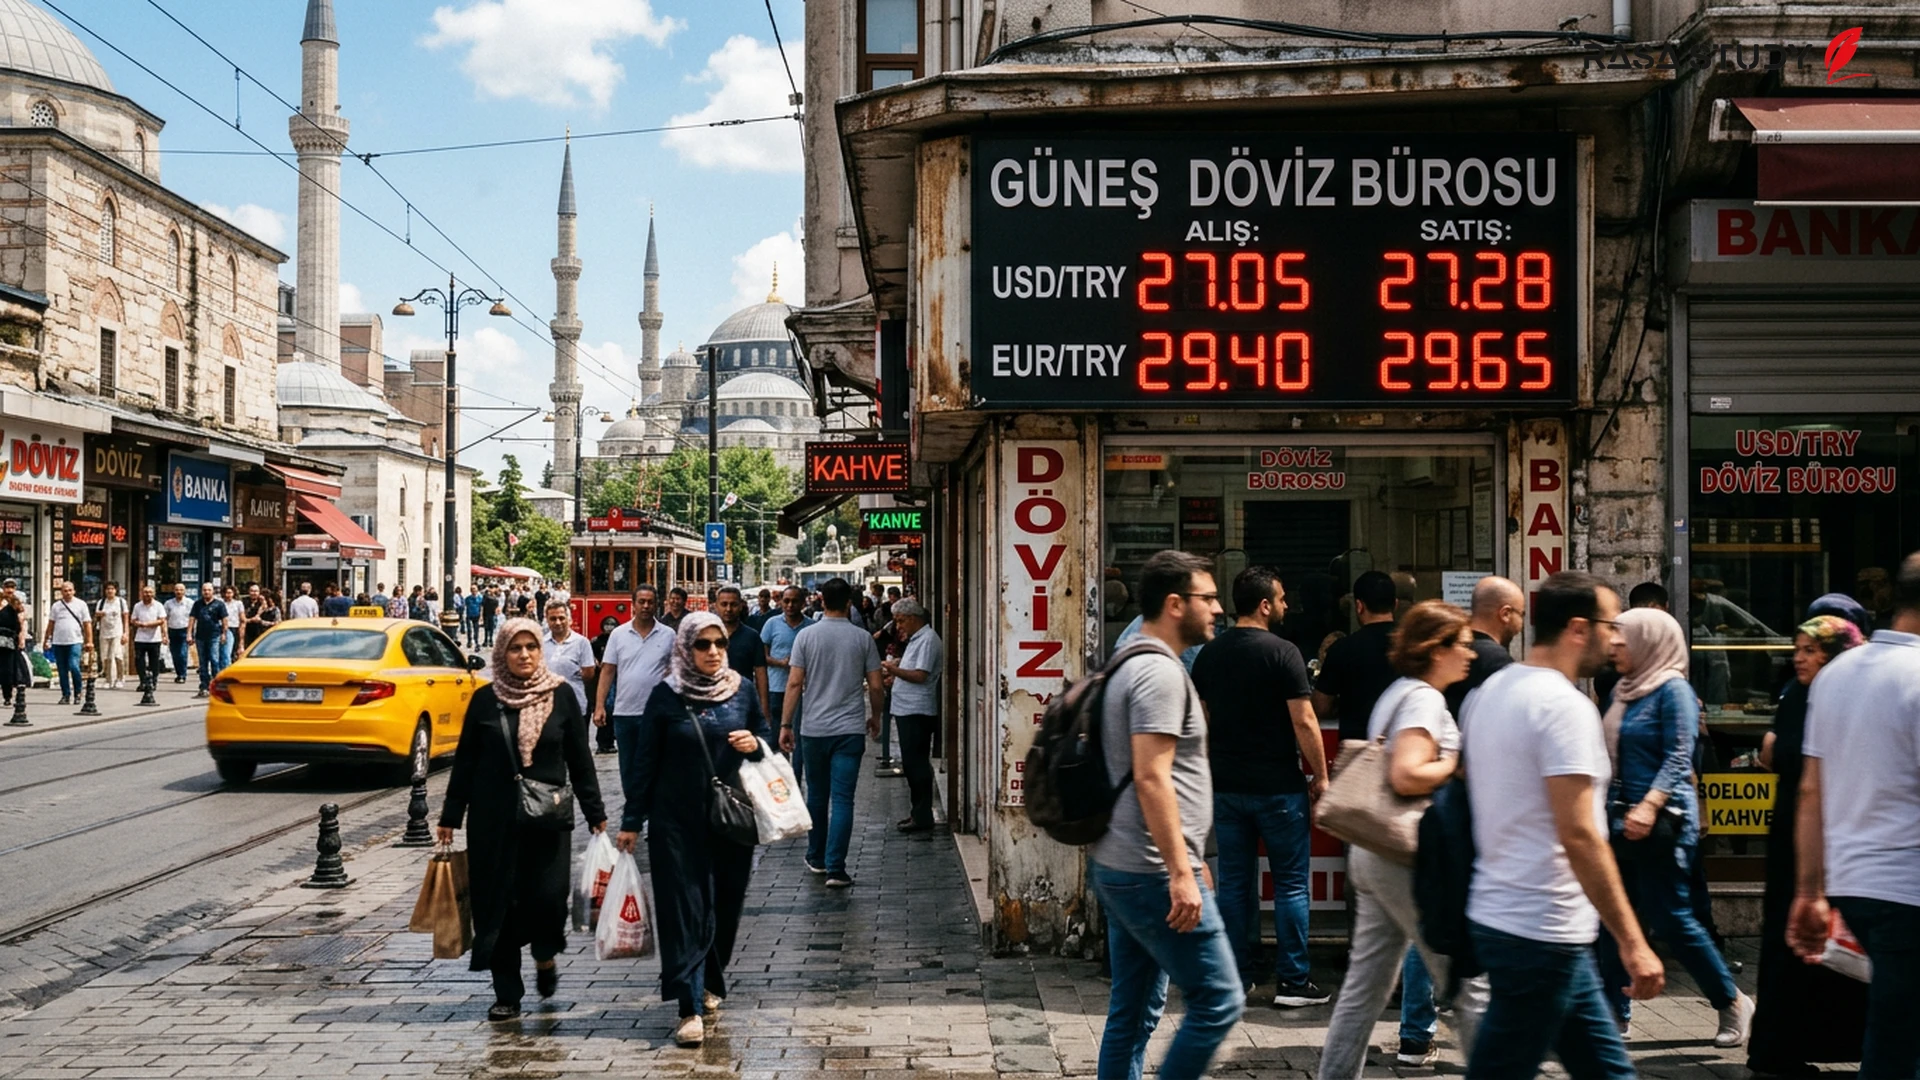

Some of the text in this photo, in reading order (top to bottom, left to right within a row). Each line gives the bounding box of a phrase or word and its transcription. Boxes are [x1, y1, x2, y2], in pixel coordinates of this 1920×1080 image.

[990, 146, 1556, 220] GÜNEŞ DÖVİZ BÜROSU
[1185, 219, 1512, 247] ALIŞ: SATIŞ:
[992, 251, 1551, 311] USD/TRY 27.05 27.28
[992, 331, 1552, 391] EUR/TRY 29.40 29.65
[11, 433, 80, 482] DÖVİZ
[1261, 446, 1333, 467] DÖVİZ
[1736, 429, 1862, 457] USD/TRY
[95, 444, 143, 479] DÖVİZ
[813, 454, 902, 481] KAHVE
[184, 474, 228, 503] BANKA
[1247, 470, 1346, 491] BÜROSU
[1700, 461, 1896, 494] DÖVİZ BÜROSU
[870, 513, 922, 529] KANVE
[1527, 459, 1563, 626] BAN
[1014, 447, 1067, 678] DÖVİZ
[1711, 810, 1774, 826] KAHVE
